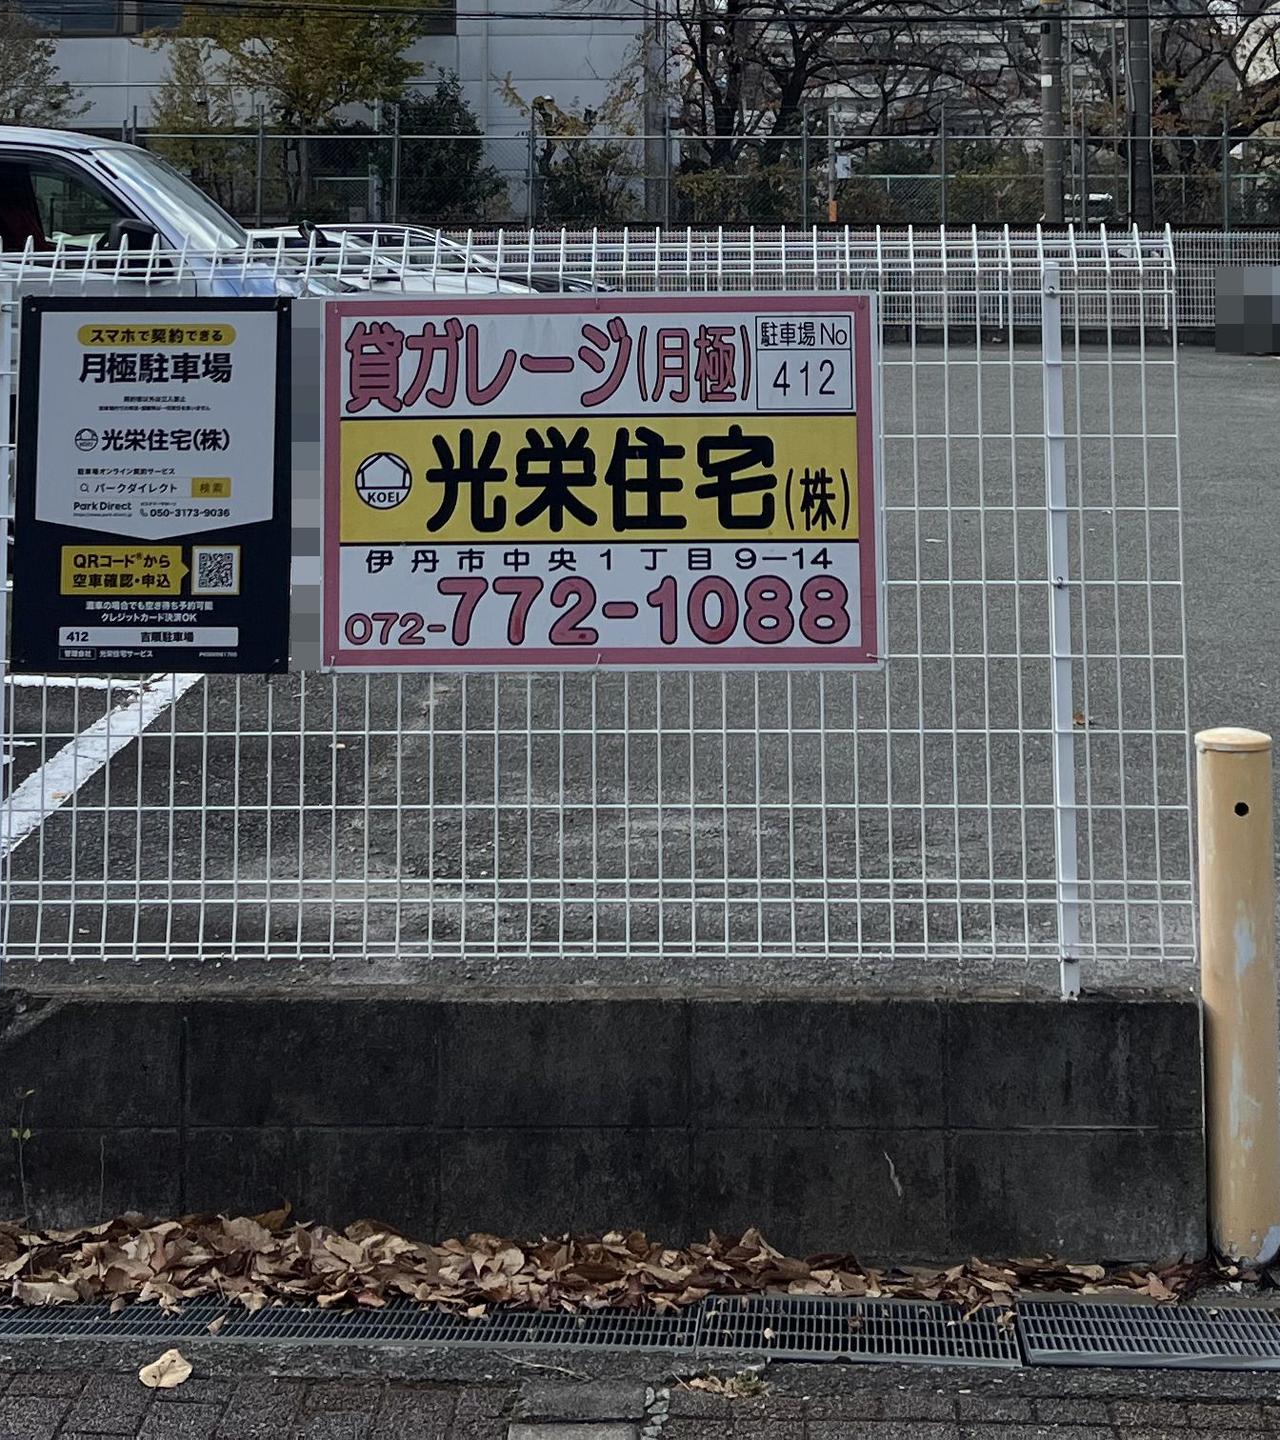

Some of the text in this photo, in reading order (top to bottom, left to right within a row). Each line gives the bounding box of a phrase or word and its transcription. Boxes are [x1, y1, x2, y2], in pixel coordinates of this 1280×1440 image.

[91, 328, 223, 343] スマホで契約できる
[79, 352, 233, 384] 月極駐車場
[345, 317, 751, 414] 貸ガレージ(月極)
[773, 359, 837, 397] 412
[101, 428, 230, 451] 光栄住宅(株)
[95, 483, 178, 494] パークダイレクト
[367, 491, 400, 504] KOEI
[73, 501, 98, 510] Park
[100, 501, 132, 510] Direct
[150, 508, 231, 518] 050-3173-9036
[72, 573, 171, 588] 空車確認・申込
[101, 613, 197, 622] クレジットカード決済OK
[345, 574, 851, 647] 072-772-1088
[66, 631, 89, 643] 412
